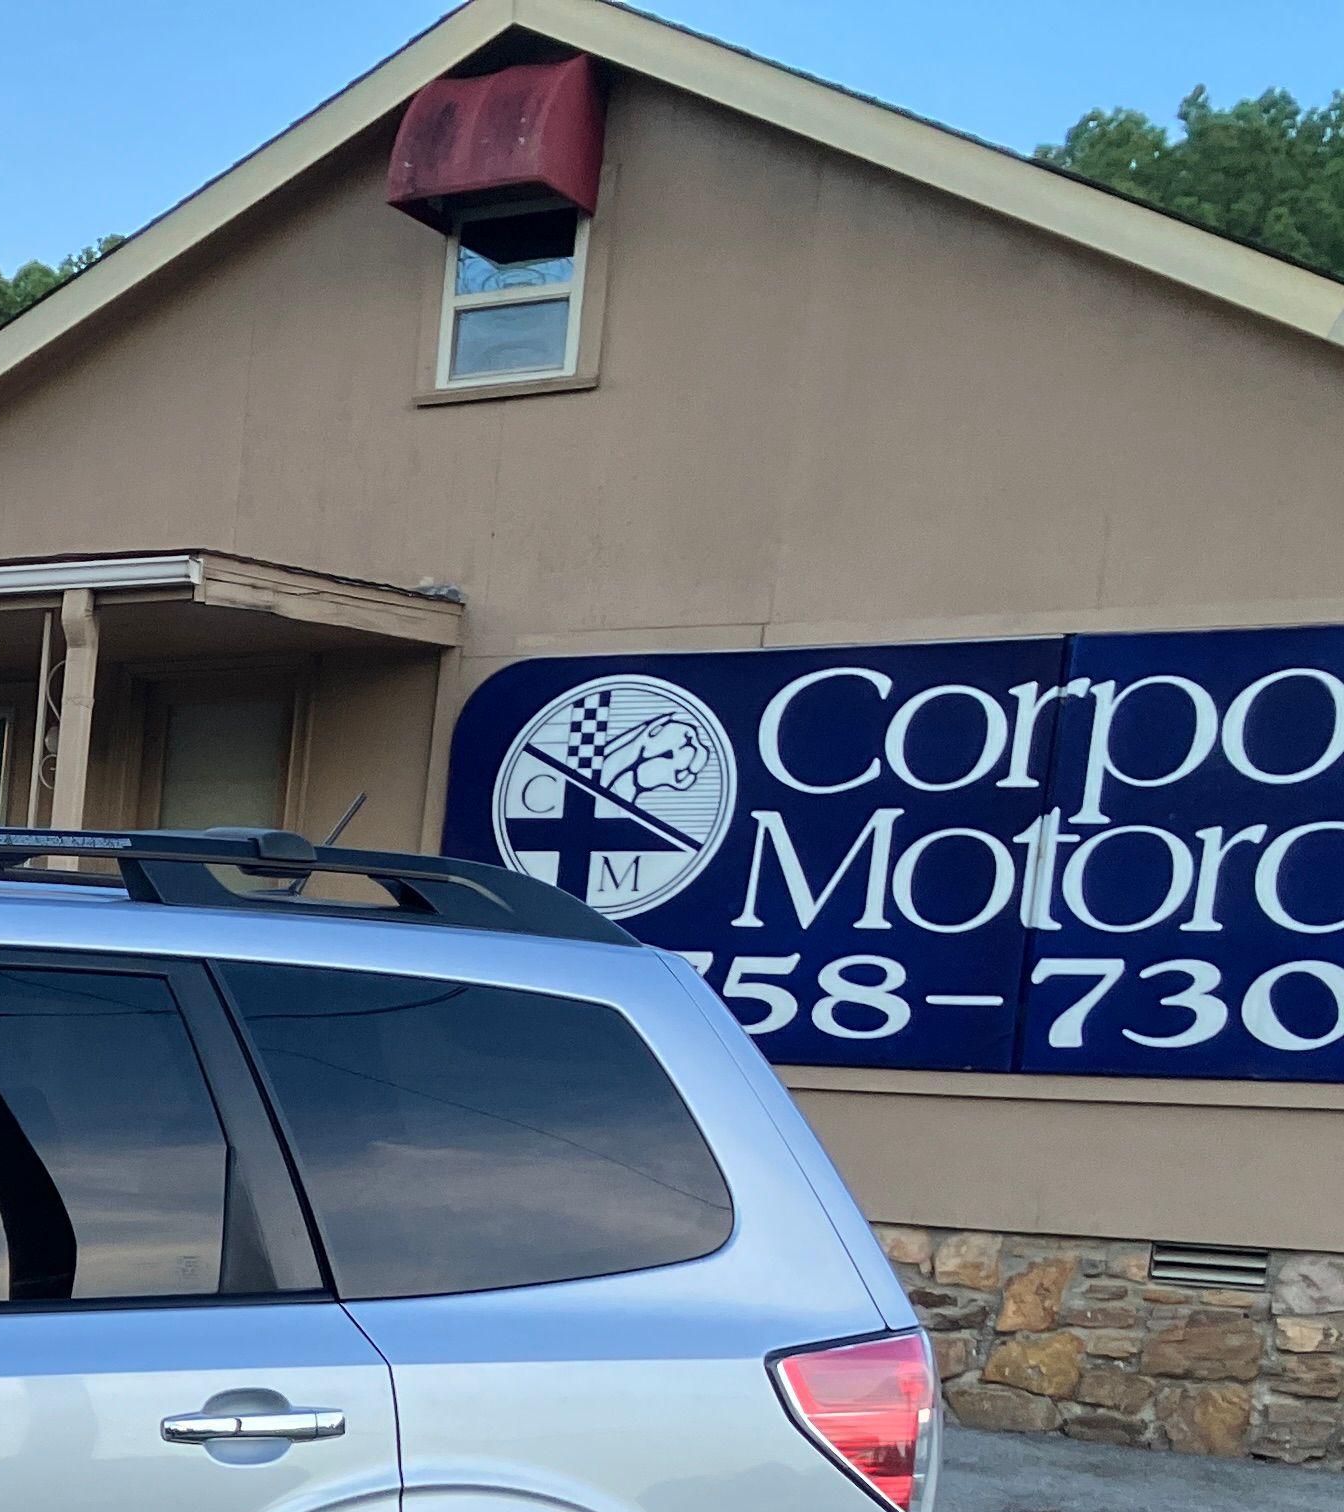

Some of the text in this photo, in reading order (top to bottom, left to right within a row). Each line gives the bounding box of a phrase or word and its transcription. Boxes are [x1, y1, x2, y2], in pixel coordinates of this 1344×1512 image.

[758, 667, 1344, 824] Corpo
[521, 774, 558, 814] C
[598, 854, 642, 893] M
[672, 950, 1344, 1051] 58-730
